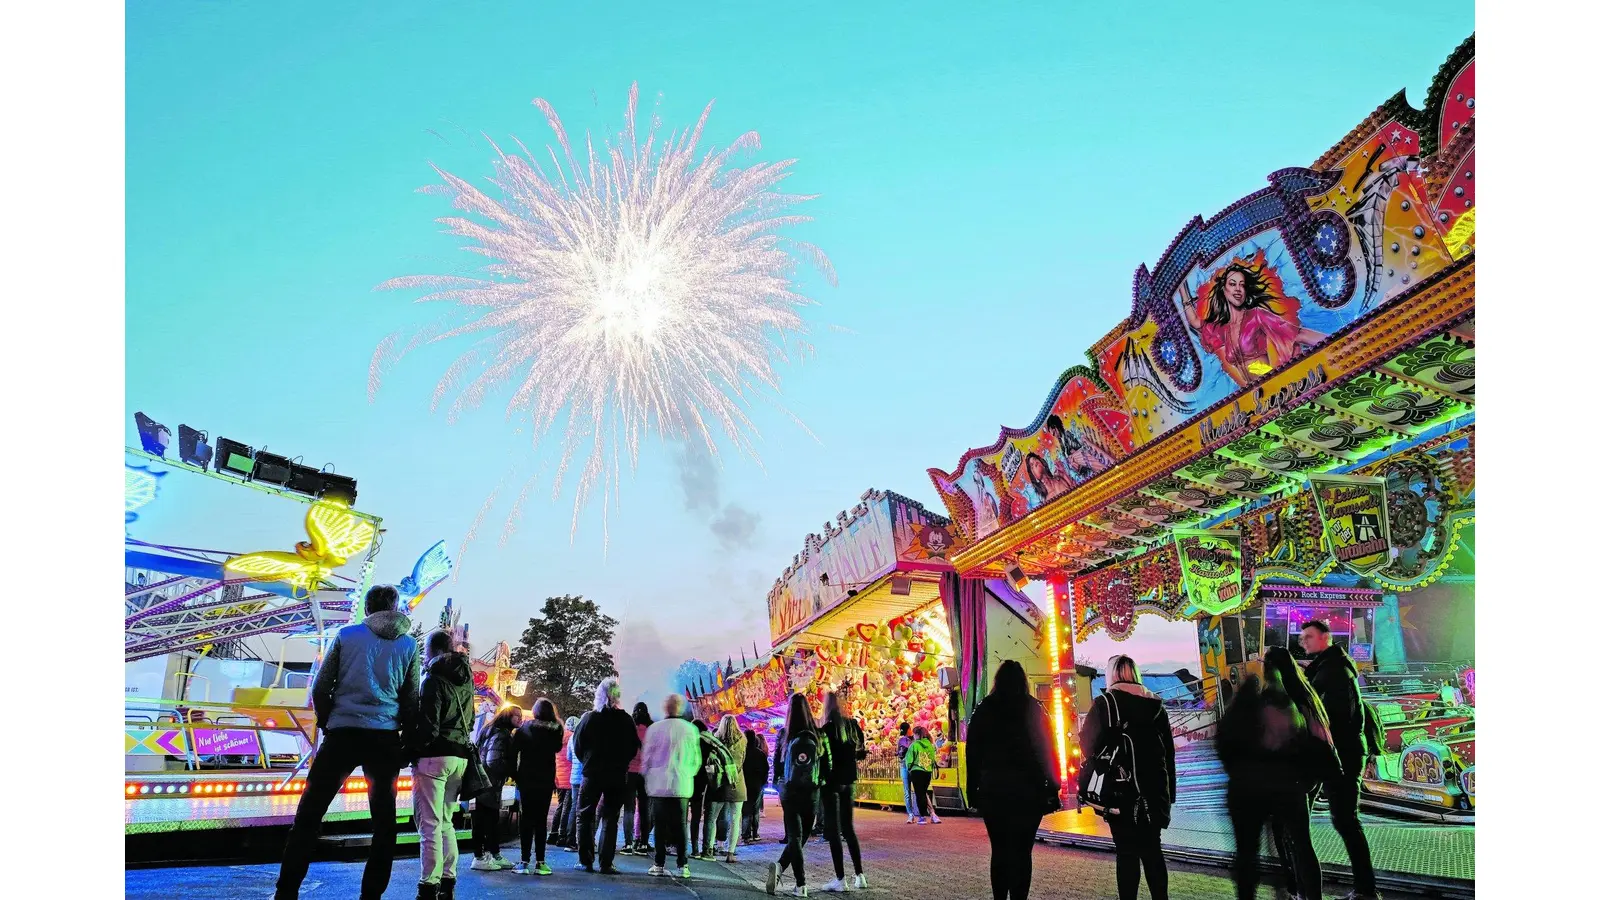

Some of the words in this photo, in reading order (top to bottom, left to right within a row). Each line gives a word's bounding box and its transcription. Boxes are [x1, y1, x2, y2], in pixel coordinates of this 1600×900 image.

[1331, 520, 1342, 535] vor
[1340, 527, 1352, 543] der
[1335, 536, 1388, 562] Autobahn
[1320, 591, 1347, 600] Express
[198, 737, 212, 747] Nur
[213, 731, 228, 743] Liebe
